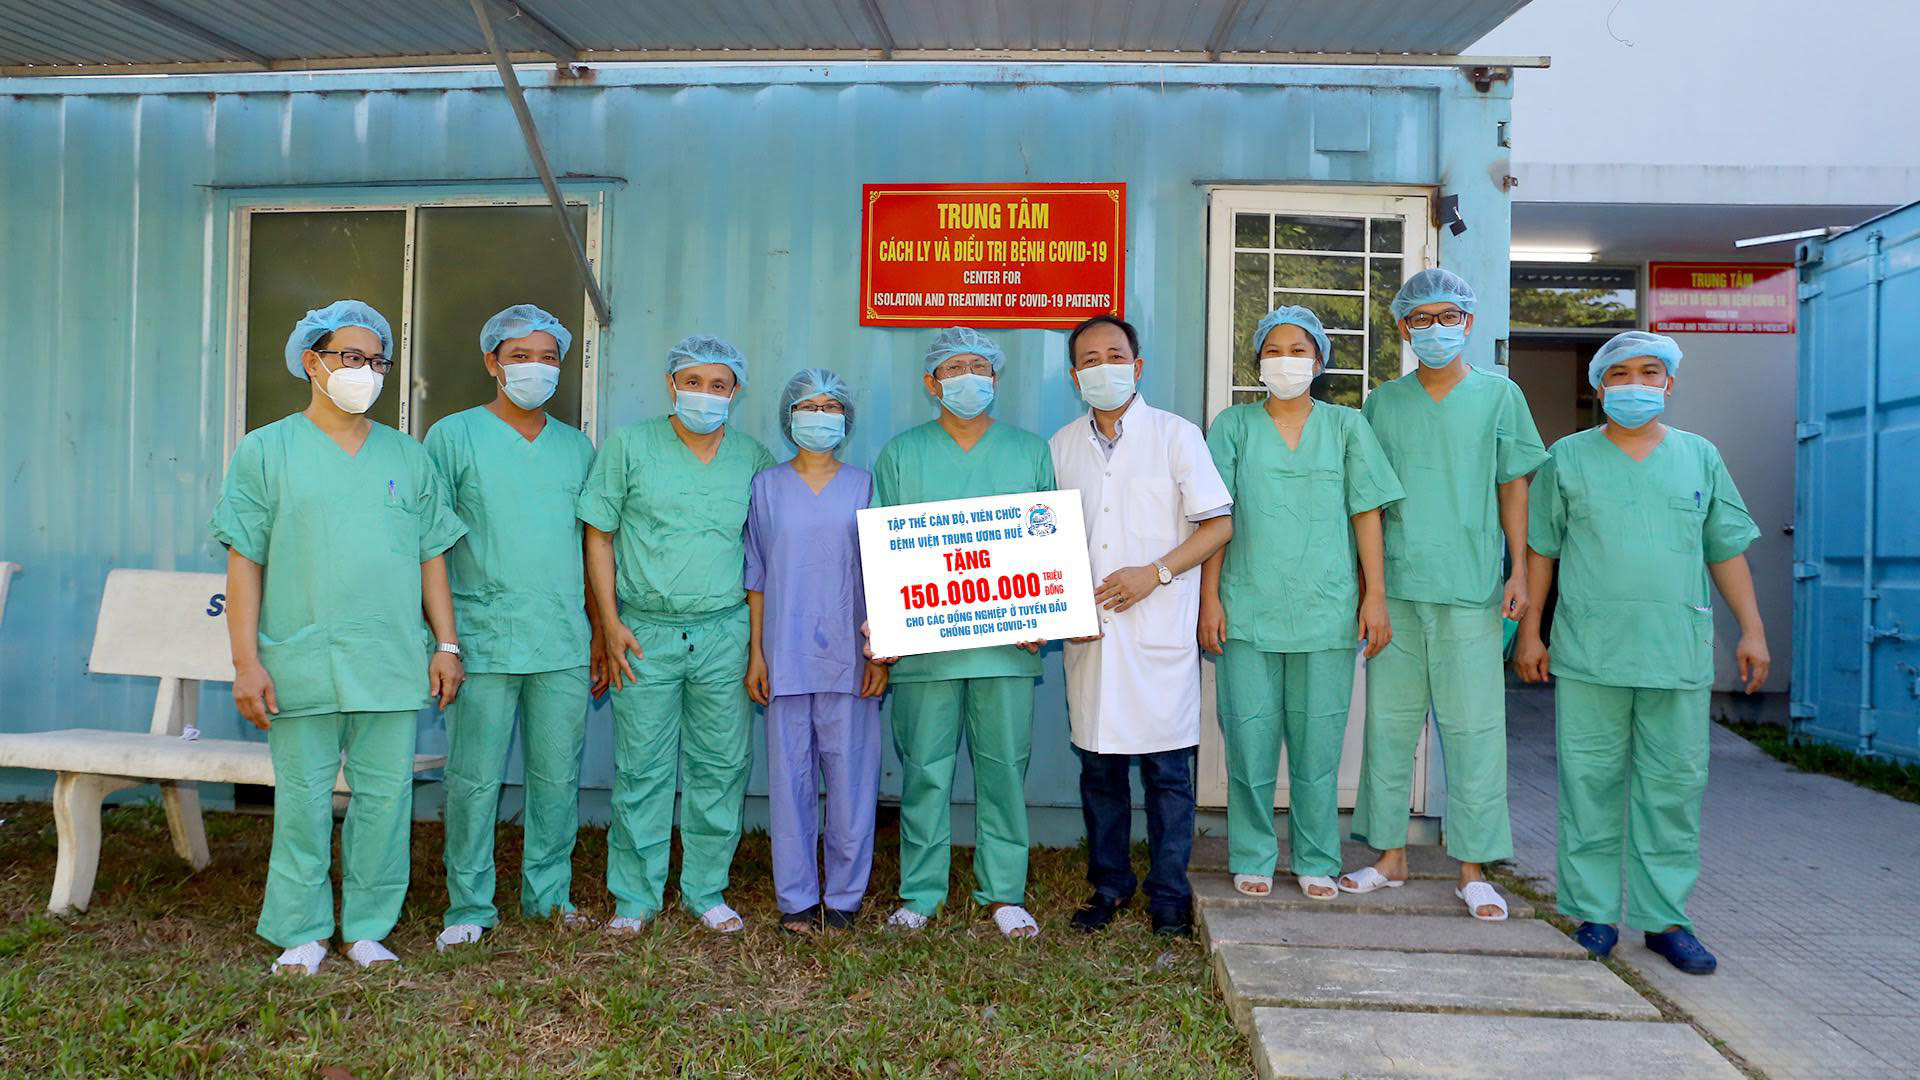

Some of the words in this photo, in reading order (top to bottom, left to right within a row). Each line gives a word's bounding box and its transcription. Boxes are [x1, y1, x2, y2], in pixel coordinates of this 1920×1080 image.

[937, 203, 1001, 230] TRUNG
[1007, 197, 1049, 229] TÂM
[879, 236, 913, 262] CÁCH
[917, 241, 930, 262] LY
[934, 236, 951, 262] VÀ
[953, 234, 983, 262] ĐIỀU
[987, 241, 1007, 266] TRỊ
[1010, 237, 1045, 266] BỆNH
[1048, 241, 1107, 263] COVID-19
[963, 271, 1000, 284] CENTER
[1003, 271, 1021, 284] FOR
[1691, 272, 1727, 288] TRUNG
[1730, 270, 1754, 288] TÂM
[874, 293, 923, 307] ISOLATION
[925, 293, 945, 307] AND
[948, 293, 1003, 307] TREATMENT
[1005, 294, 1017, 307] OF
[1019, 294, 1063, 307] COVID-19
[1065, 294, 1110, 308] PATIENTS
[887, 517, 906, 533] TẬP
[908, 512, 927, 529] THỂ
[929, 513, 950, 527] CÁN
[952, 510, 969, 526] BỘ,
[970, 509, 993, 524] VIÊN
[995, 506, 1022, 521] CHỨC
[890, 536, 916, 552] BỆNH
[917, 534, 940, 549] VIỆN
[942, 532, 973, 546] TRUNG
[976, 529, 1001, 543] ƯƠNG
[1004, 524, 1023, 539] HUẾ
[943, 548, 991, 575] TẶNG
[1042, 569, 1063, 582] TRIỆU
[900, 572, 1041, 610] 150.000.000
[1044, 583, 1064, 596] ĐỒNG
[906, 616, 925, 628] CHO
[927, 612, 945, 626] CÁC
[947, 608, 973, 624] ĐỒNG
[975, 605, 1007, 622] NGHIỆP
[1010, 602, 1017, 617] Ở
[1018, 601, 1047, 616] TUYẾN
[1048, 598, 1068, 613] ĐẦU
[940, 622, 971, 638] CHỐNG
[973, 622, 995, 637] DỊCH
[997, 618, 1038, 632] COVID-19
